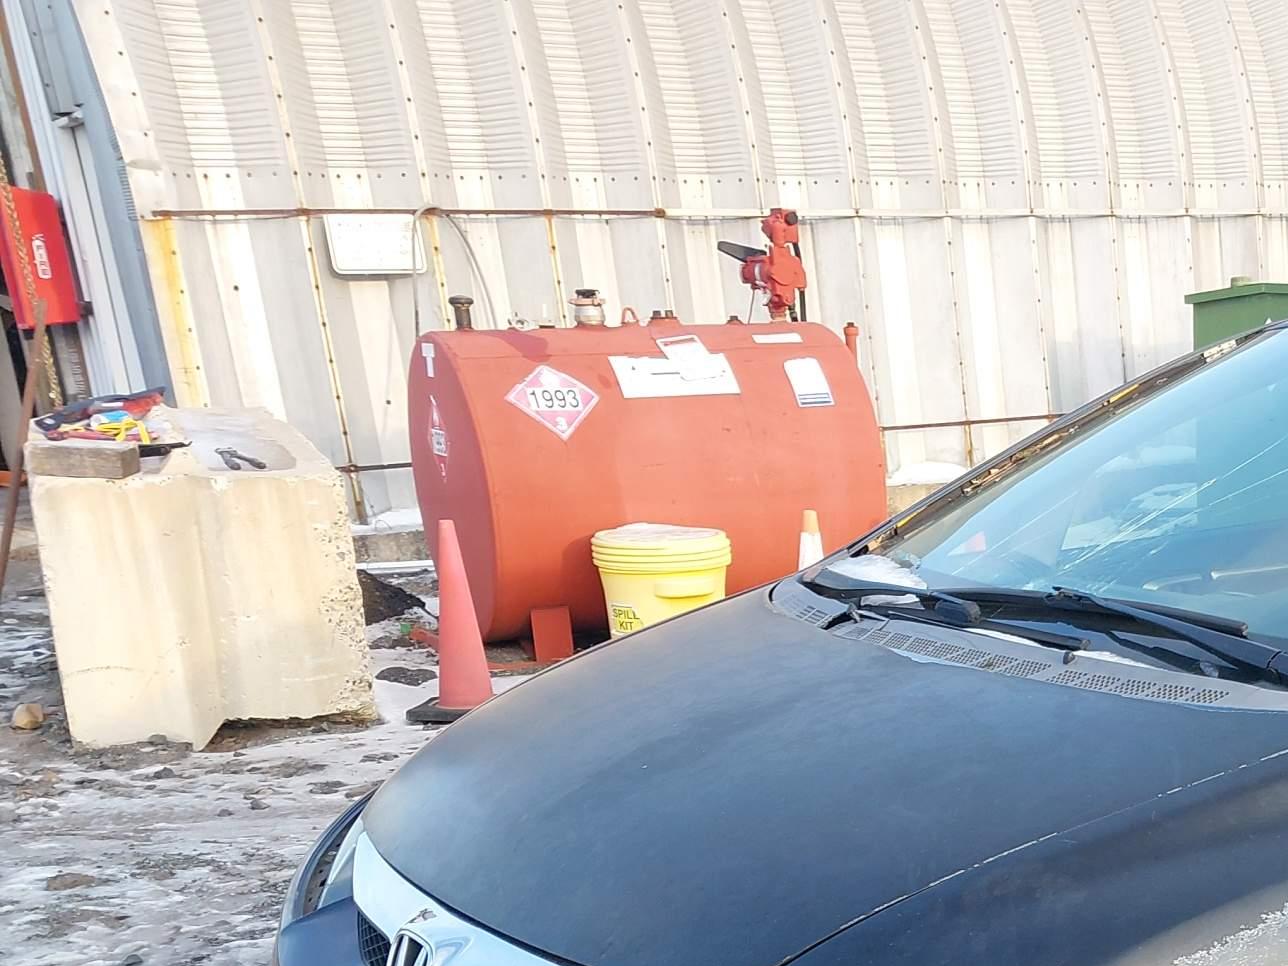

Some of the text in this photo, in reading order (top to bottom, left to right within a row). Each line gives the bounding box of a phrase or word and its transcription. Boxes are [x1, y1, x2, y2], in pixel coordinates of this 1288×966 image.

[529, 388, 580, 410] 1993
[555, 416, 568, 431] 3
[612, 608, 640, 620] SPILL
[619, 620, 634, 631] KIT
